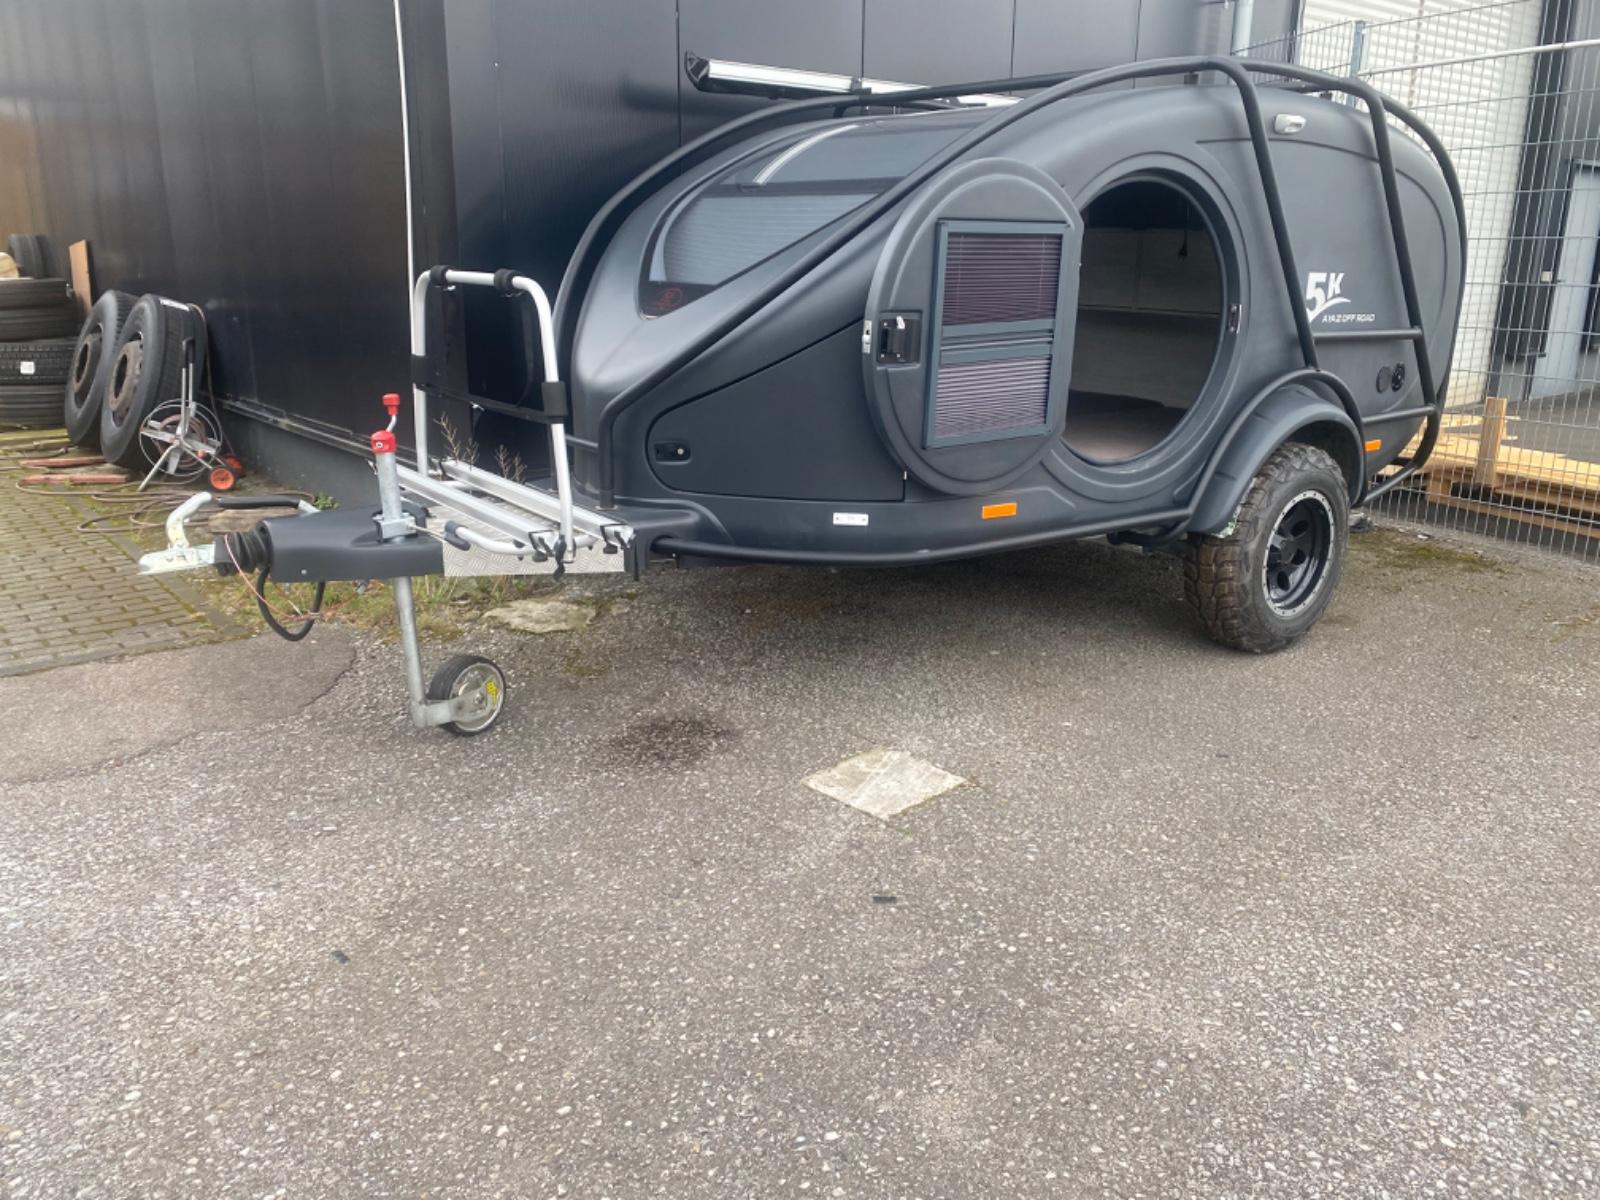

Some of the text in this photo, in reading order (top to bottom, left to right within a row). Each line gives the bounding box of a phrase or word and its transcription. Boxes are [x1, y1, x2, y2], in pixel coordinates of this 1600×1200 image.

[1306, 272, 1345, 322] 5K
[1342, 313, 1357, 322] OFF
[1356, 313, 1376, 322] ROAD
